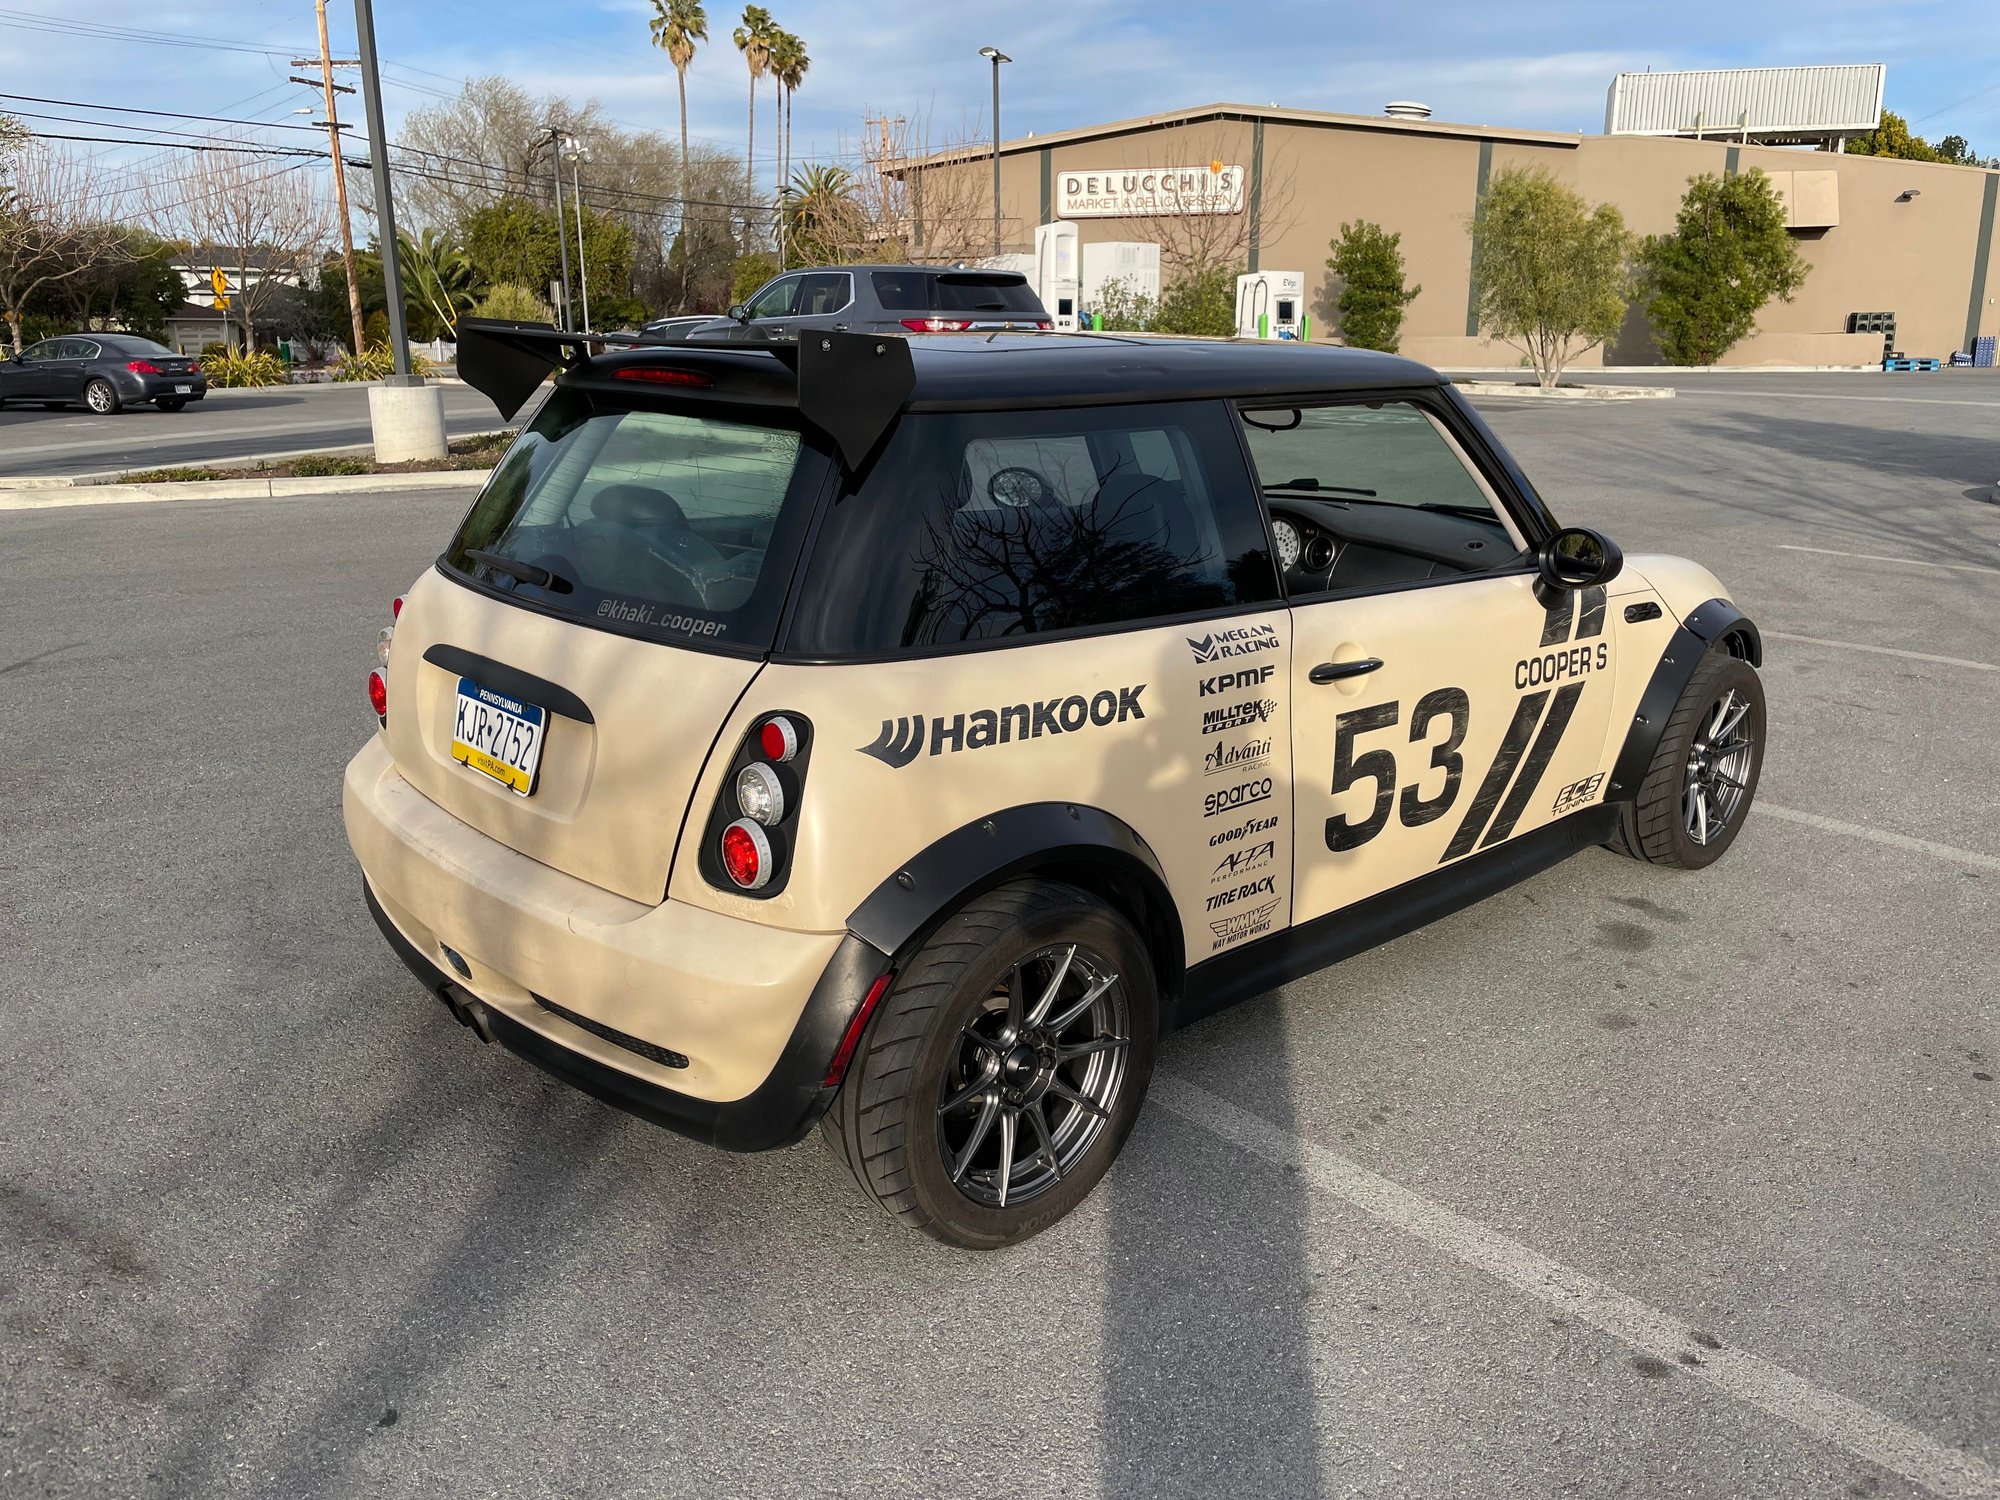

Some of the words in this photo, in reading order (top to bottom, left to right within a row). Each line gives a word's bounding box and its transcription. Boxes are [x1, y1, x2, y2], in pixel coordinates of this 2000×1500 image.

[1067, 197, 1119, 210] MARKET
[1123, 198, 1131, 209] &
[596, 599, 726, 637] @khaki_cooper
[1213, 624, 1275, 644] MEGAN
[1221, 636, 1280, 658] RACING
[1199, 665, 1275, 697] KPMF
[1515, 646, 1591, 690] COOPER
[1596, 643, 1607, 670] S
[480, 689, 522, 715] PENNSYLVANIA
[1205, 716, 1252, 734] SPORT
[477, 756, 506, 777] visitPA.com
[1205, 737, 1272, 770] Advanti
[1242, 760, 1271, 773] RACING
[1324, 686, 1470, 852] 53
[1203, 777, 1272, 815] sparco
[1551, 793, 1596, 816] TUNING
[1553, 772, 1606, 809] ECS
[1209, 816, 1278, 847] GOODYEAR
[1212, 841, 1274, 876] ALTA
[1212, 937, 1226, 951] WAY
[1227, 927, 1248, 945] MOTOR
[1249, 920, 1271, 936] WORKS
